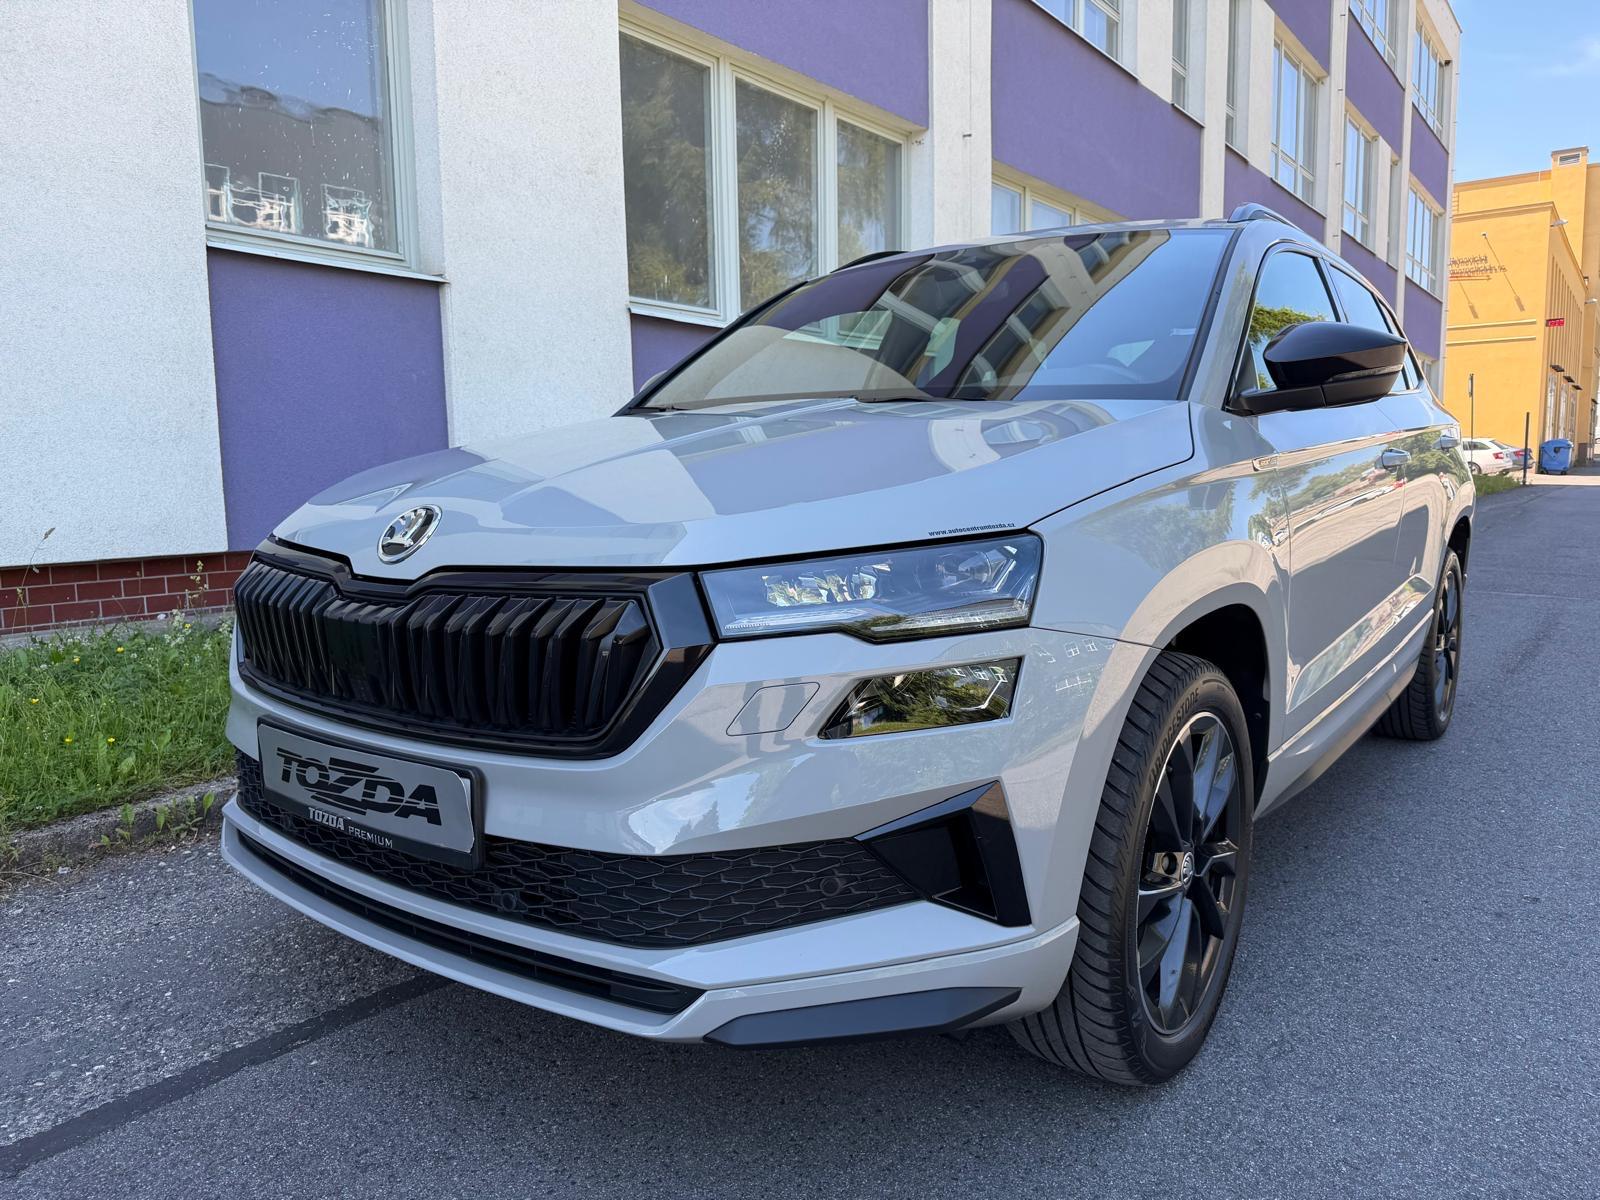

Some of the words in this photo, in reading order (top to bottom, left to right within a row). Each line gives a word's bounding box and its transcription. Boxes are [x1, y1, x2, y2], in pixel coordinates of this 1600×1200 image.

[276, 747, 442, 826] TOZDA
[308, 806, 345, 831] TOZDA
[348, 825, 393, 848] PREMIUM
